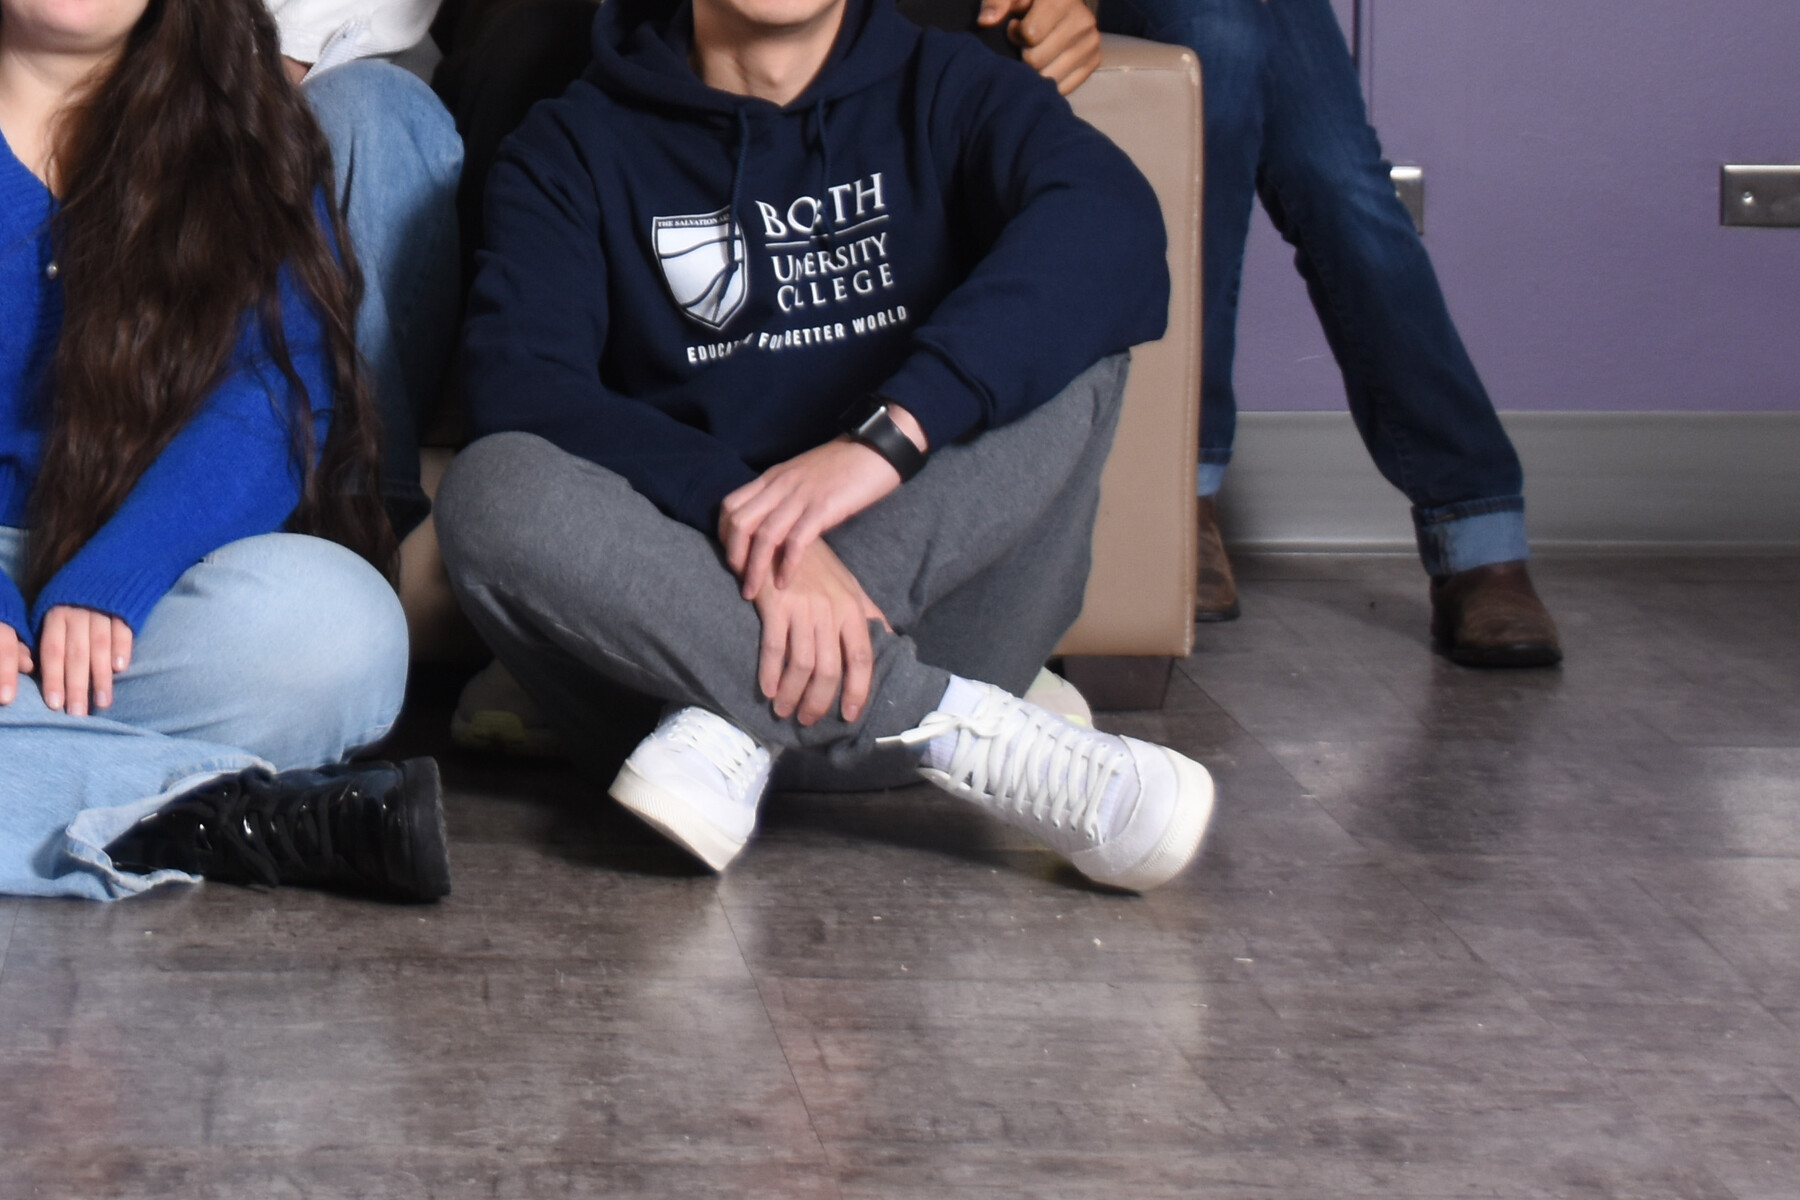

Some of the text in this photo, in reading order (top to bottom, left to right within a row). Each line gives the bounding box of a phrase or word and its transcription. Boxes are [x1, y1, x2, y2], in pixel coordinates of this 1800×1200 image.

[674, 217, 718, 227] SALVATION
[784, 322, 846, 347] BETTER
[851, 304, 908, 335] WORLD
